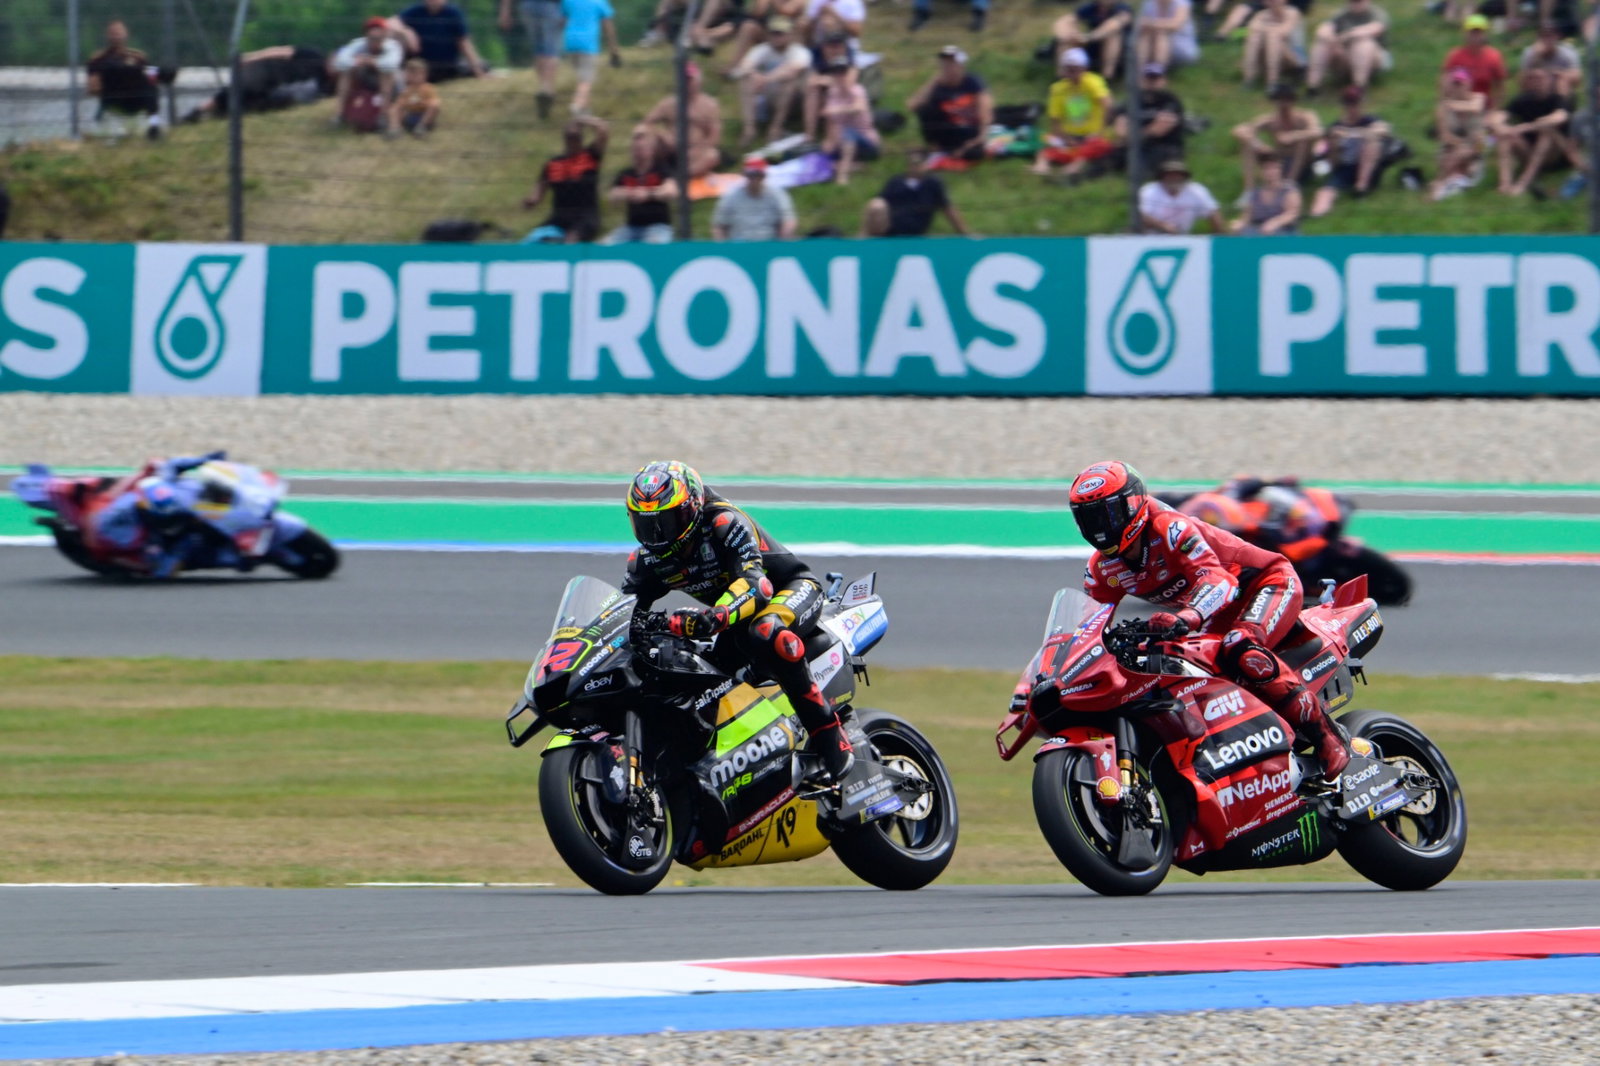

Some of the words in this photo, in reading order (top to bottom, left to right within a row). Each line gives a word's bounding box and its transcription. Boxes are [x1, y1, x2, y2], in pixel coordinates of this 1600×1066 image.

[311, 253, 1048, 382] PETRONAS
[1258, 252, 1600, 377] PETR
[578, 635, 625, 676] mooneygo
[1061, 654, 1092, 682] motorola
[1311, 655, 1337, 675] motorola
[584, 673, 613, 692] ebay
[1060, 682, 1094, 697] CARRERA
[1128, 685, 1145, 699] Audi
[1144, 675, 1162, 690] Sport
[1204, 690, 1246, 721] GIVI
[1203, 726, 1283, 770] Lenovo
[1231, 769, 1290, 801] NetApp
[1264, 790, 1293, 811] SIEMENS
[720, 827, 765, 862] BARDAHL
[1251, 828, 1301, 857] MONSTER
